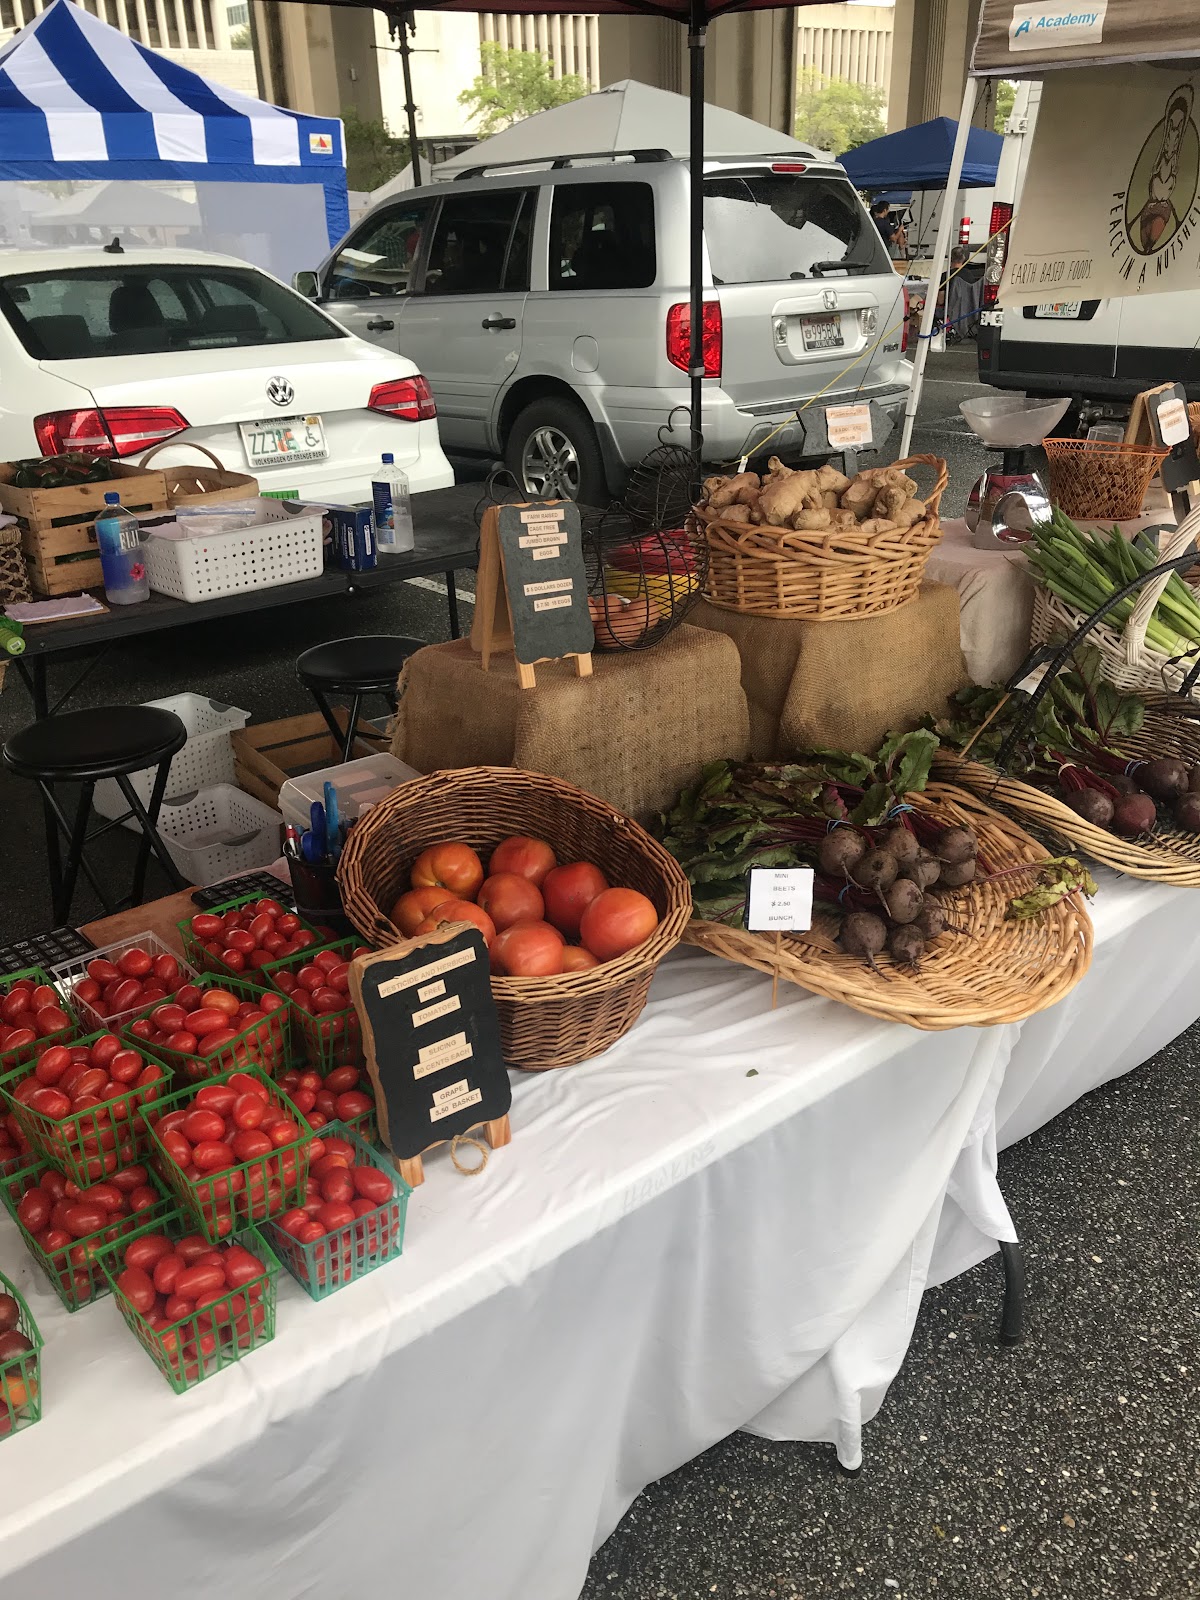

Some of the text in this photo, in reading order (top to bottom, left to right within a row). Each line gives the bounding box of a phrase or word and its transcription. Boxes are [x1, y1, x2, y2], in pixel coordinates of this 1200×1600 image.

[1035, 13, 1099, 29] Academy
[1108, 191, 1126, 258] PEACE
[1118, 254, 1136, 281] IN
[1138, 262, 1147, 284] A
[1010, 263, 1038, 285] EARTH
[1039, 261, 1066, 283] BASED
[255, 457, 286, 466] VOLKSWAGEN
[294, 453, 312, 461] ORANGE
[119, 529, 140, 550] FIJI
[534, 584, 556, 592] DOLLARS
[556, 581, 573, 589] DOZEN
[381, 952, 475, 996] PESTICIDE AND HERBICIDE
[423, 984, 443, 997] FREE
[417, 1000, 457, 1021] TOMATOES
[428, 1039, 457, 1056] SLICING
[416, 1047, 470, 1075] 50 CENTS EACH
[439, 1084, 464, 1100] GRAPE
[452, 1092, 480, 1109] BASKET
